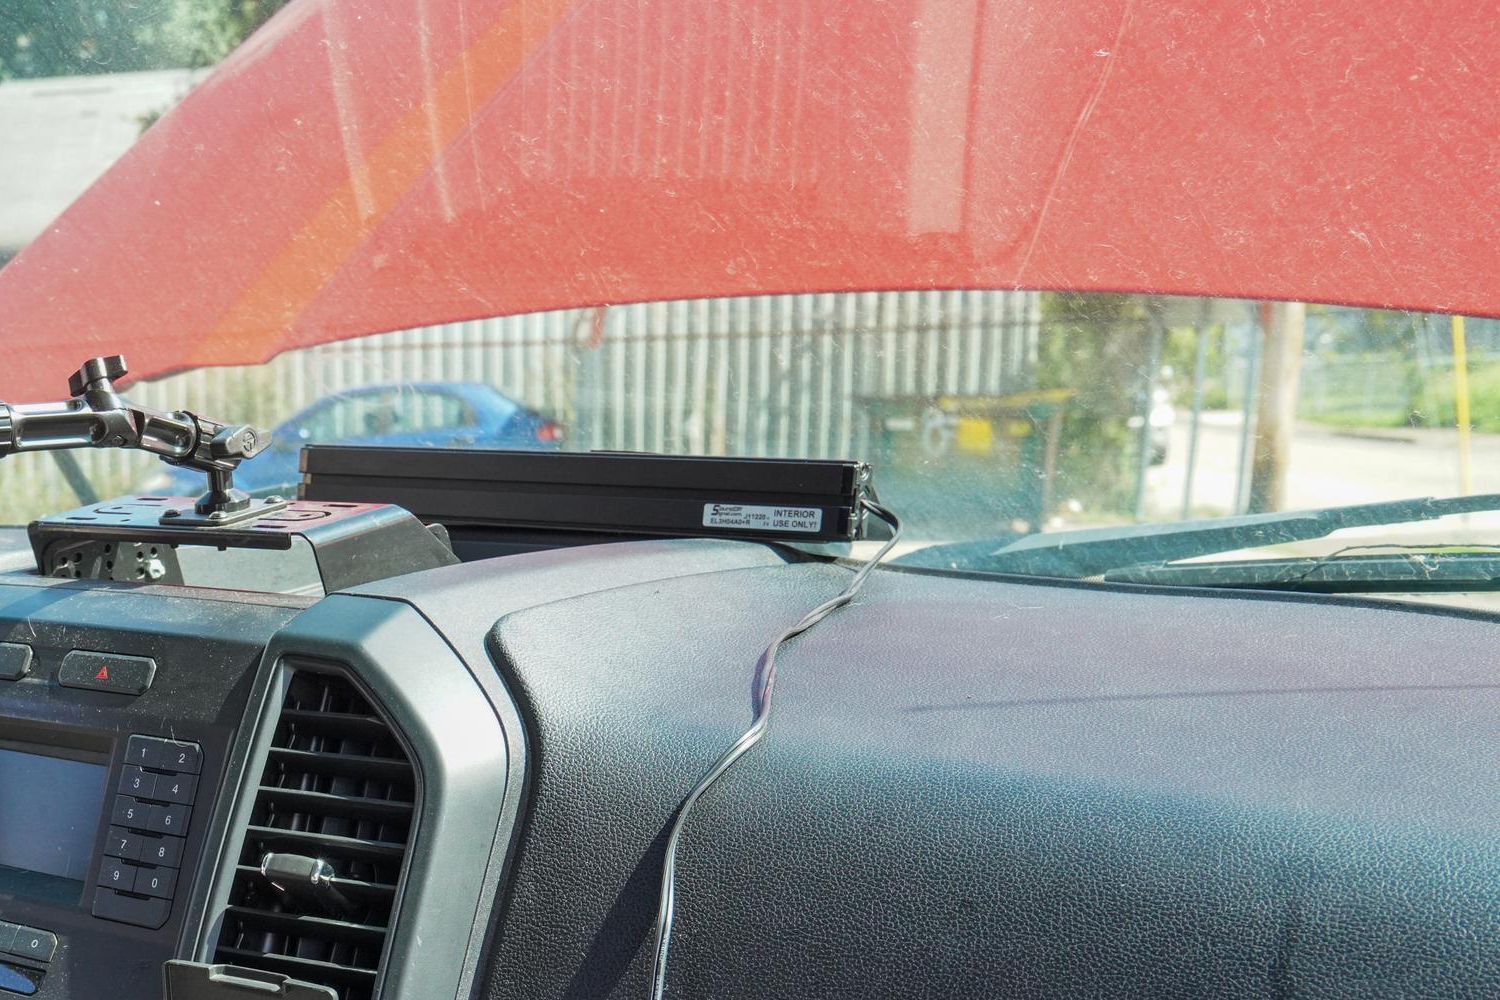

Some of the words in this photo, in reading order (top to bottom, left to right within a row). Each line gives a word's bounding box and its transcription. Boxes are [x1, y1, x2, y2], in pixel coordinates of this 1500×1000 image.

[773, 509, 816, 519] INTERIOR
[772, 520, 789, 528] USE
[791, 520, 817, 529] ONLY!
[178, 753, 186, 764] 2
[133, 778, 140, 789] 3
[172, 784, 179, 795] 4
[127, 808, 134, 819] 5
[165, 815, 172, 826] 6
[120, 839, 127, 849] 7
[158, 847, 165, 857] 8
[113, 870, 120, 881] 9
[151, 877, 158, 889] 0
